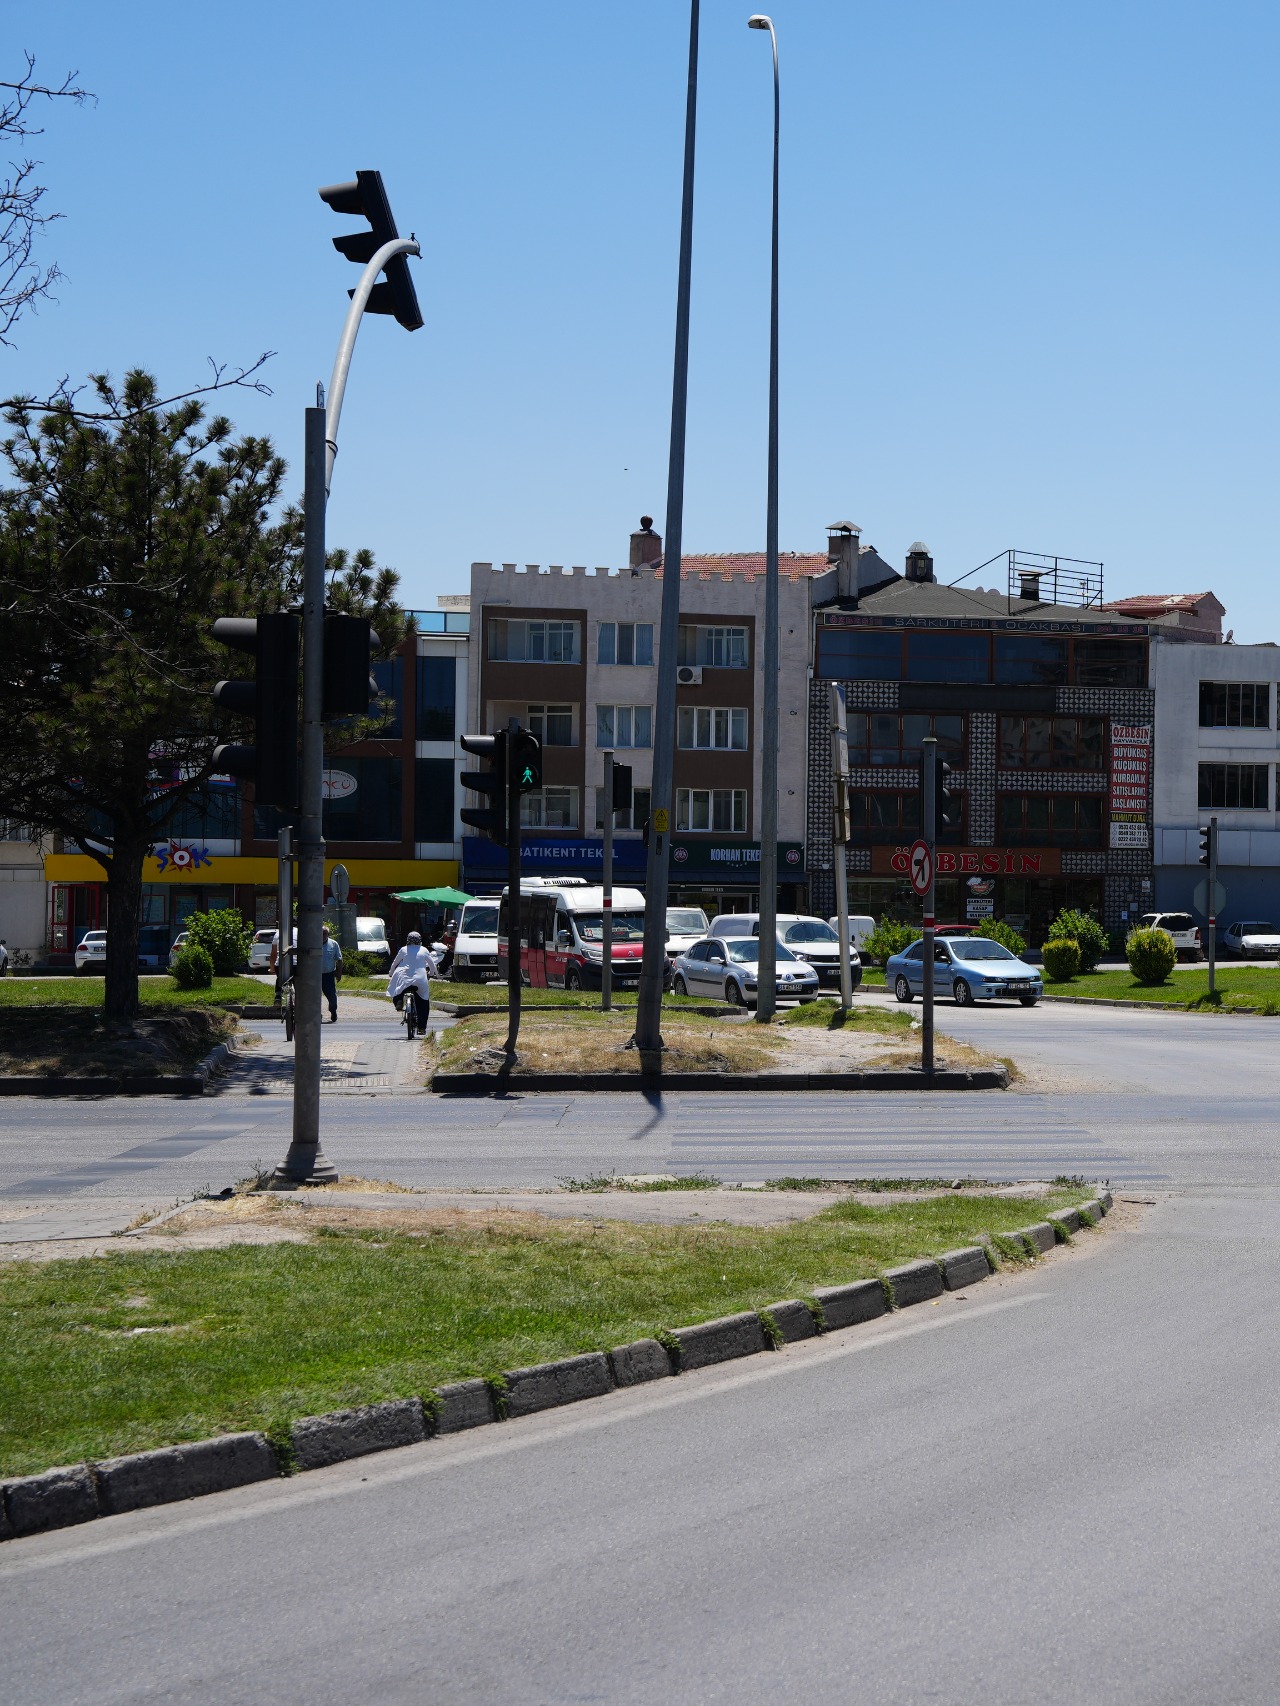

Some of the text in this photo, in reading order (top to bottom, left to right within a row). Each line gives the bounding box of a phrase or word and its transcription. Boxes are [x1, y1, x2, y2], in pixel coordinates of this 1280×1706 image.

[579, 848, 619, 858] TEKL
[710, 848, 762, 861] KORHAN TEKE
[891, 846, 1042, 874] ÖBESİN
